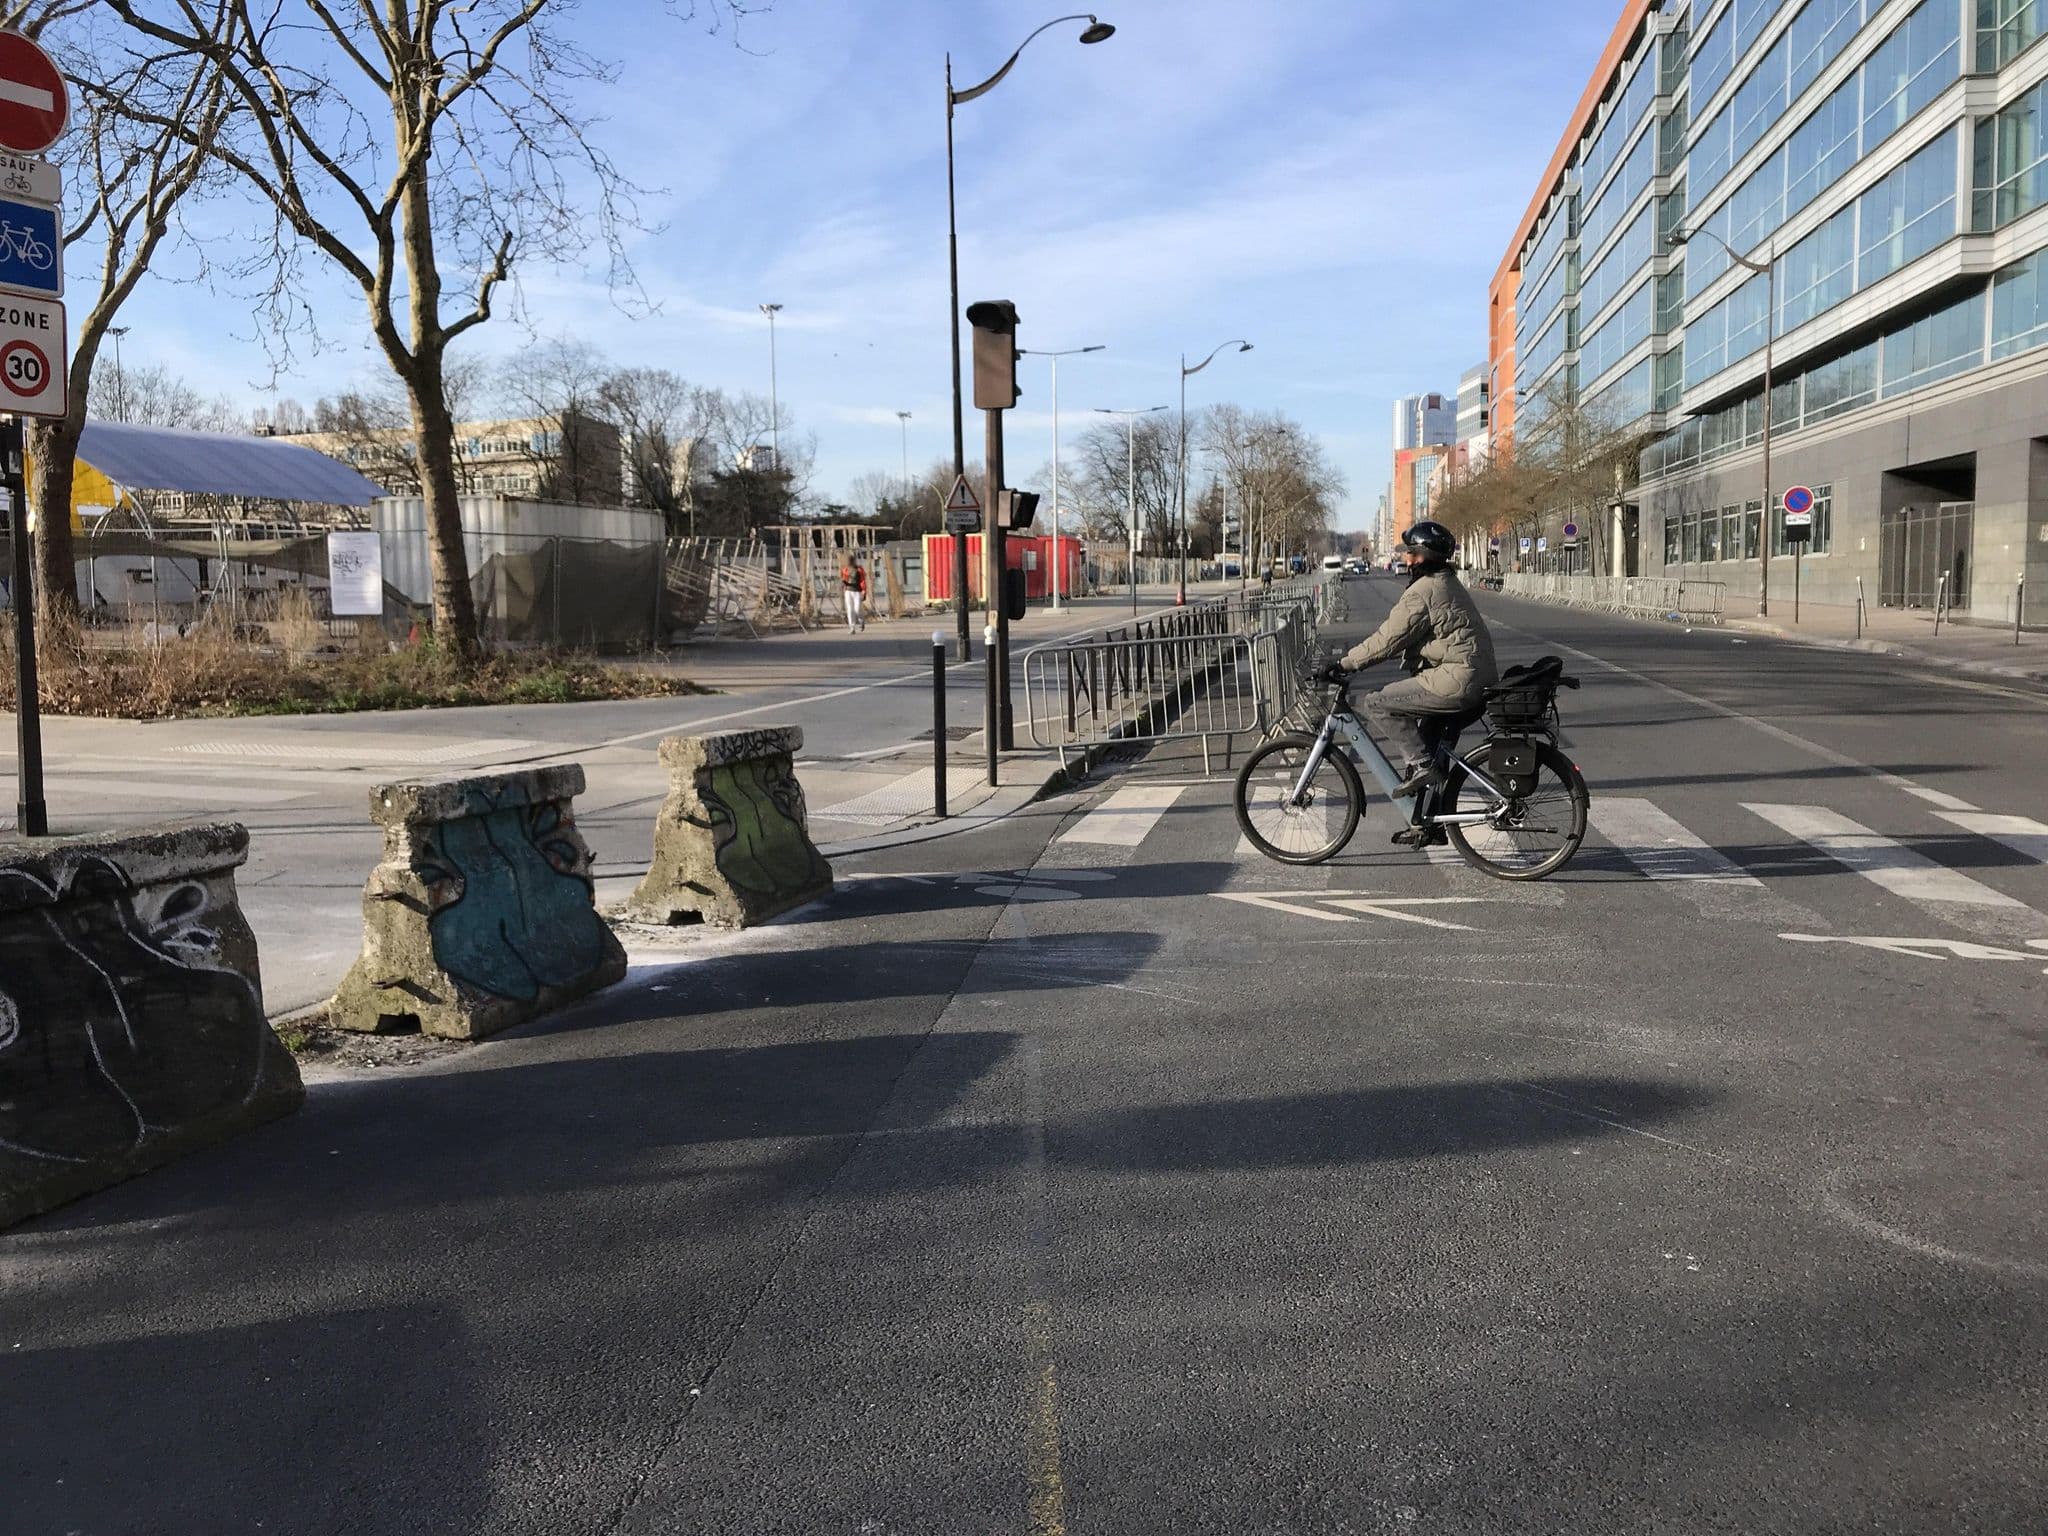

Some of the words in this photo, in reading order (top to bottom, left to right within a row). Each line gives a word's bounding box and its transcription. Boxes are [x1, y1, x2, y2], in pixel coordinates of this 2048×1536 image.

[0, 156, 36, 174] SAUF
[0, 307, 49, 330] ZONE
[9, 355, 40, 382] 30
